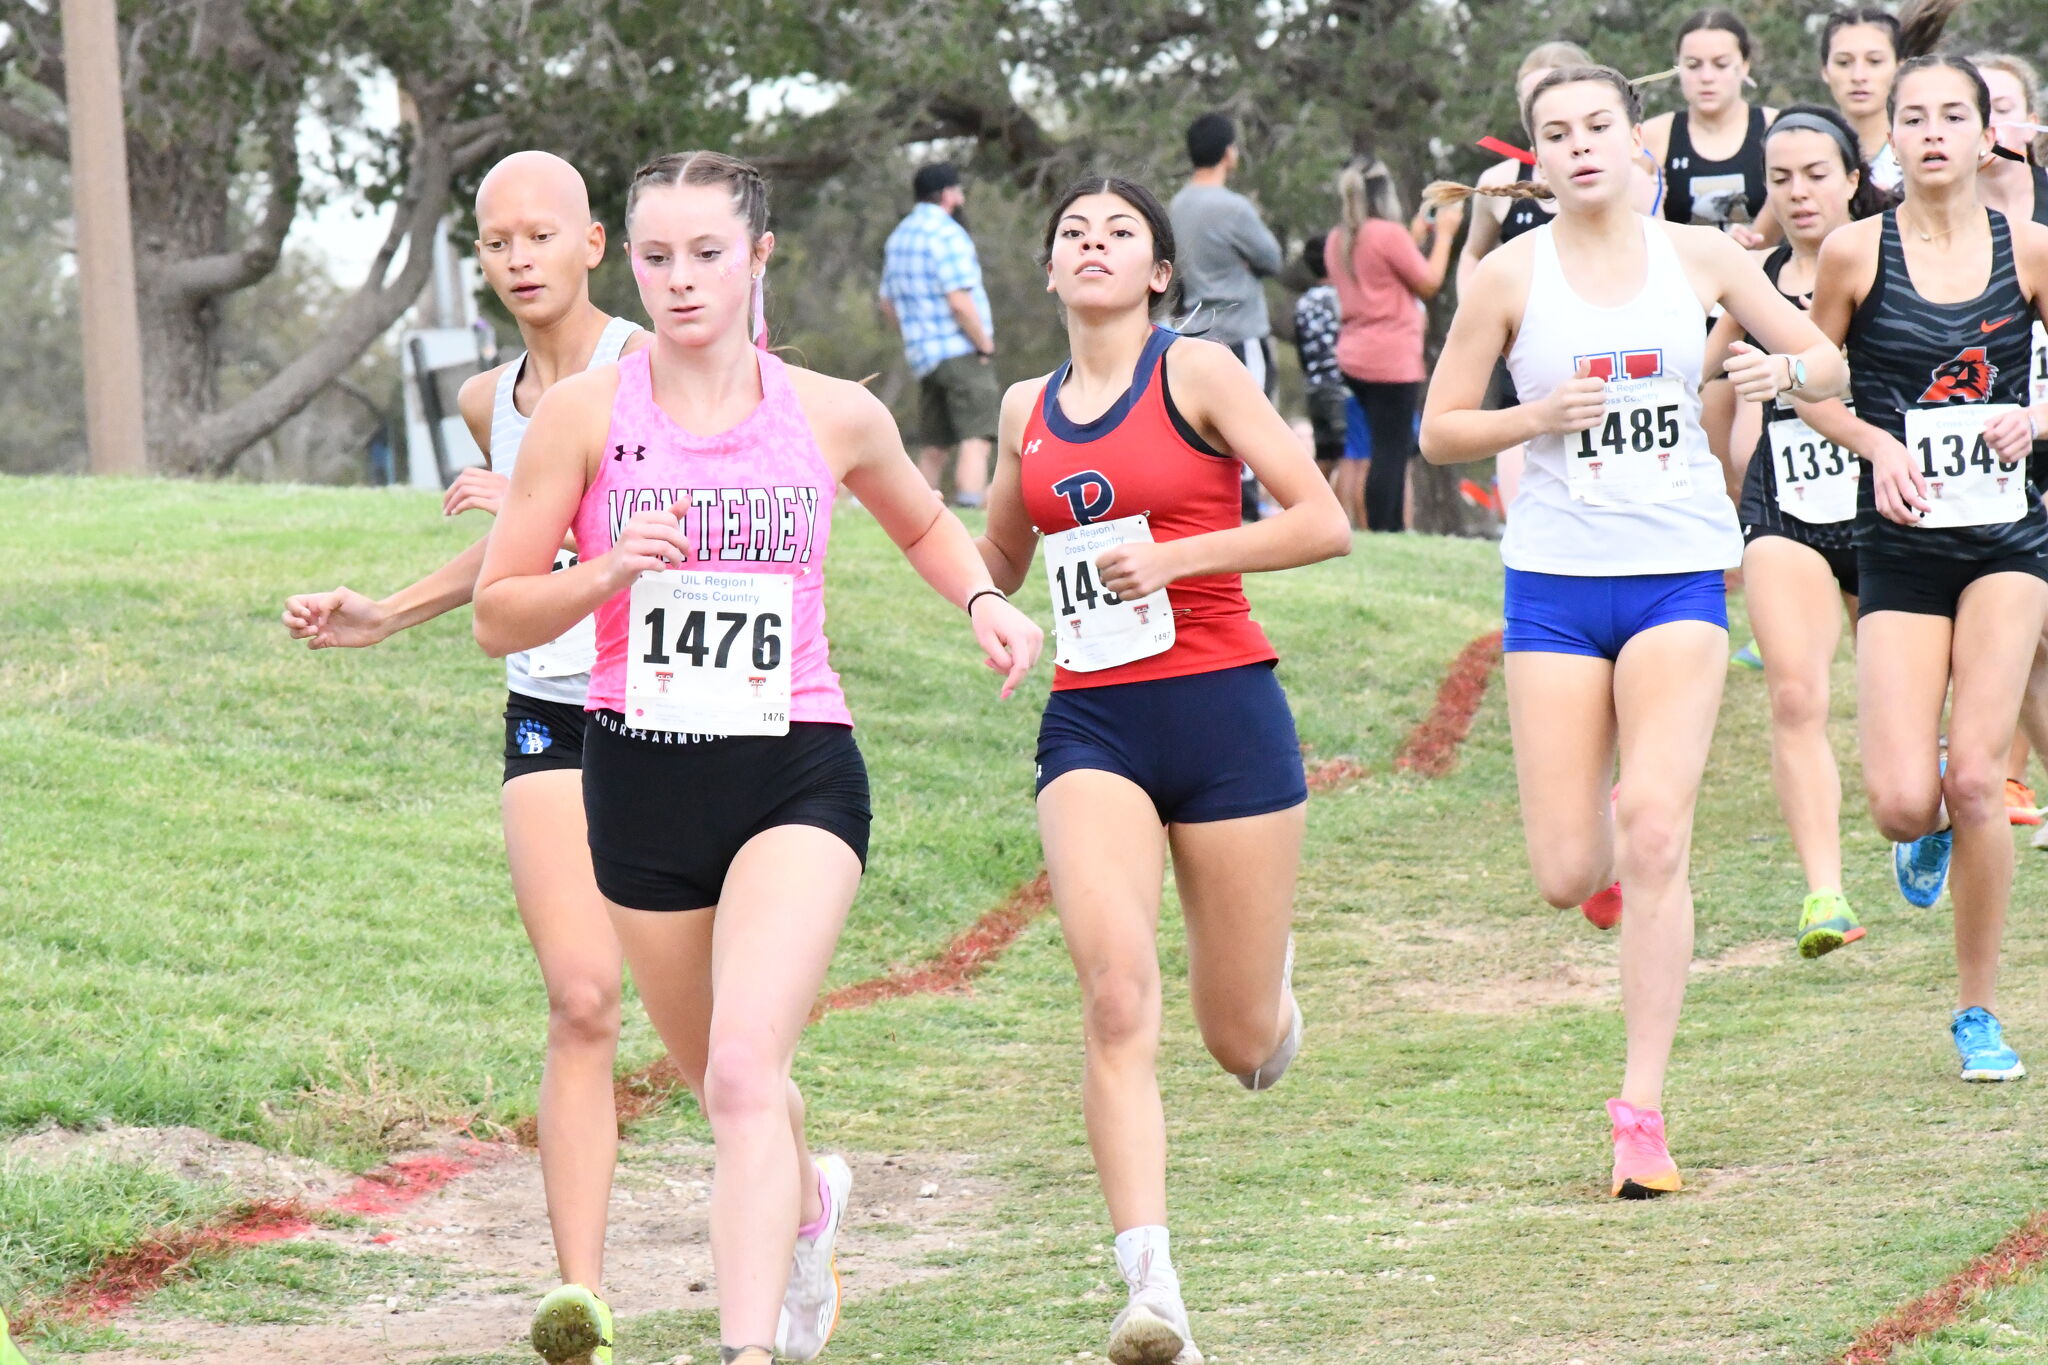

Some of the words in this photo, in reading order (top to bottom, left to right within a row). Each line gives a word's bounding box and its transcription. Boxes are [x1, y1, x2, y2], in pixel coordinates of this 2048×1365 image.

[1577, 404, 1680, 459] 1485
[1051, 470, 1115, 527] P
[608, 486, 819, 564] MTEREY
[1066, 531, 1079, 542] UIL
[1080, 526, 1110, 539] Region
[1064, 544, 1086, 555] Cross
[1087, 536, 1124, 550] Country
[673, 588, 709, 601] Cross
[712, 591, 760, 605] Country
[681, 574, 701, 585] UIL
[704, 575, 747, 588] Region
[1056, 560, 1123, 617] 14
[643, 607, 782, 671] 1476
[762, 711, 785, 723] 1476
